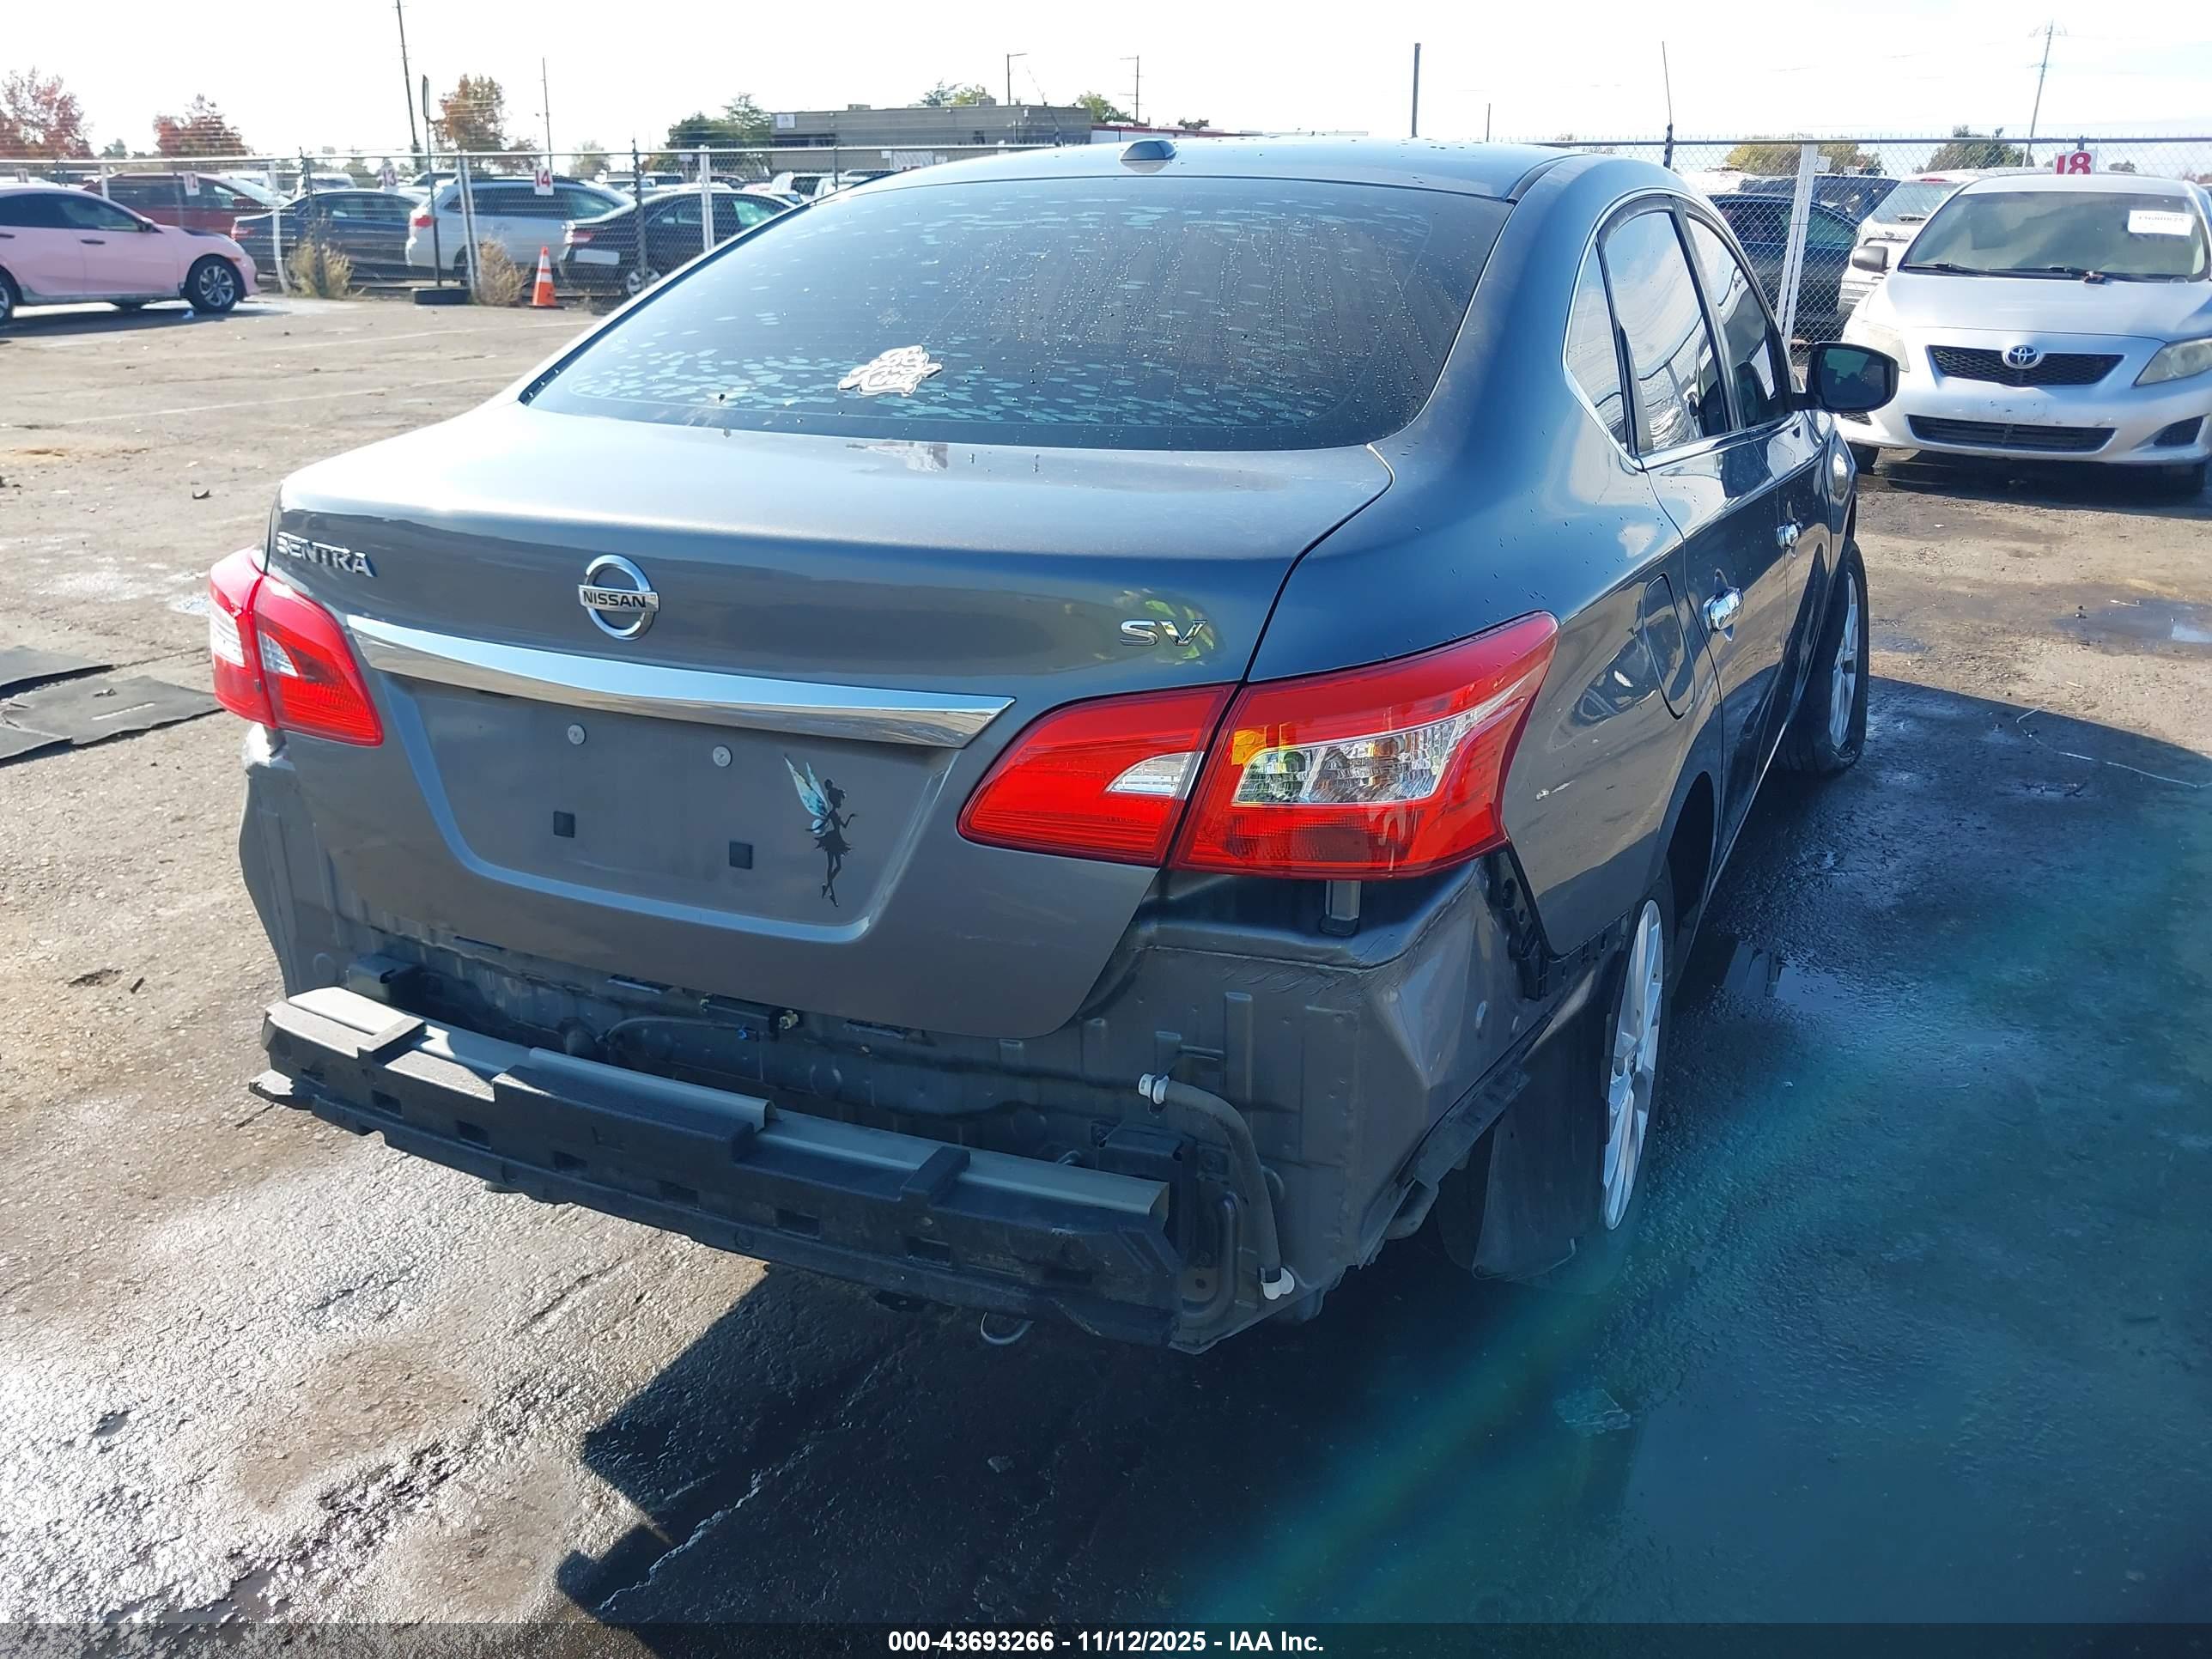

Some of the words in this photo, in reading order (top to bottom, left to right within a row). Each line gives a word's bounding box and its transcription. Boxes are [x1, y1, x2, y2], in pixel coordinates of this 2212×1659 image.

[2056, 152, 2092, 174] 18
[384, 169, 396, 185] 13
[535, 170, 550, 187] 14
[276, 531, 377, 578] SENTRA
[583, 590, 647, 608] NISSAN
[1120, 619, 1207, 646] SV
